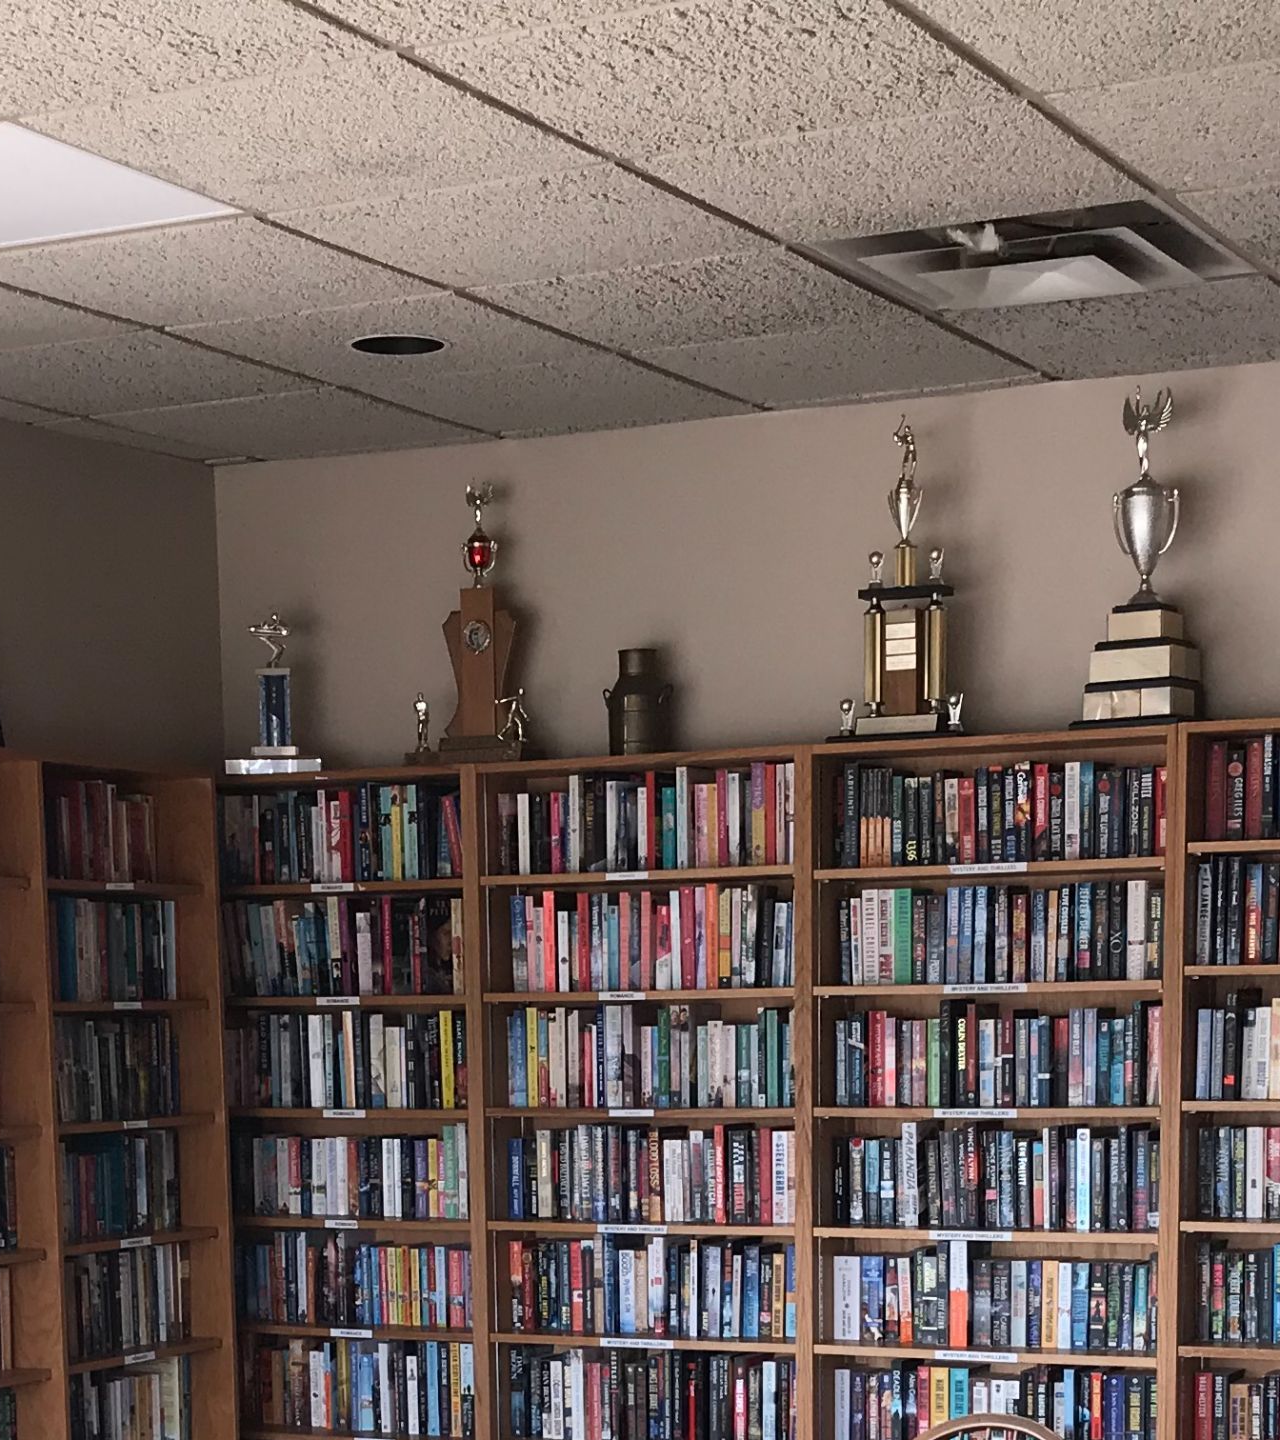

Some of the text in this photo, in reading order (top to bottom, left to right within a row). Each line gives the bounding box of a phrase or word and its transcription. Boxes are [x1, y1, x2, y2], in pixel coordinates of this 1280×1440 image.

[847, 770, 855, 816] LABYRINTH
[1131, 781, 1140, 836] KILL ZONE
[1233, 777, 1243, 817] GREG ILES
[906, 841, 918, 861] 1356
[1061, 888, 1069, 934] CLIVE CUSSLER
[1078, 887, 1090, 950] JEFFERY DEAVER
[1110, 930, 1122, 953] XO
[957, 1018, 967, 1071] COLIN DEXTER
[649, 1132, 661, 1187] BLOOD LOSS
[775, 1144, 785, 1195] STEVE BERRY
[906, 1131, 915, 1190] PARANOIA
[968, 1127, 976, 1180] VINCE FLYNN
[707, 1179, 716, 1205] PITCH
